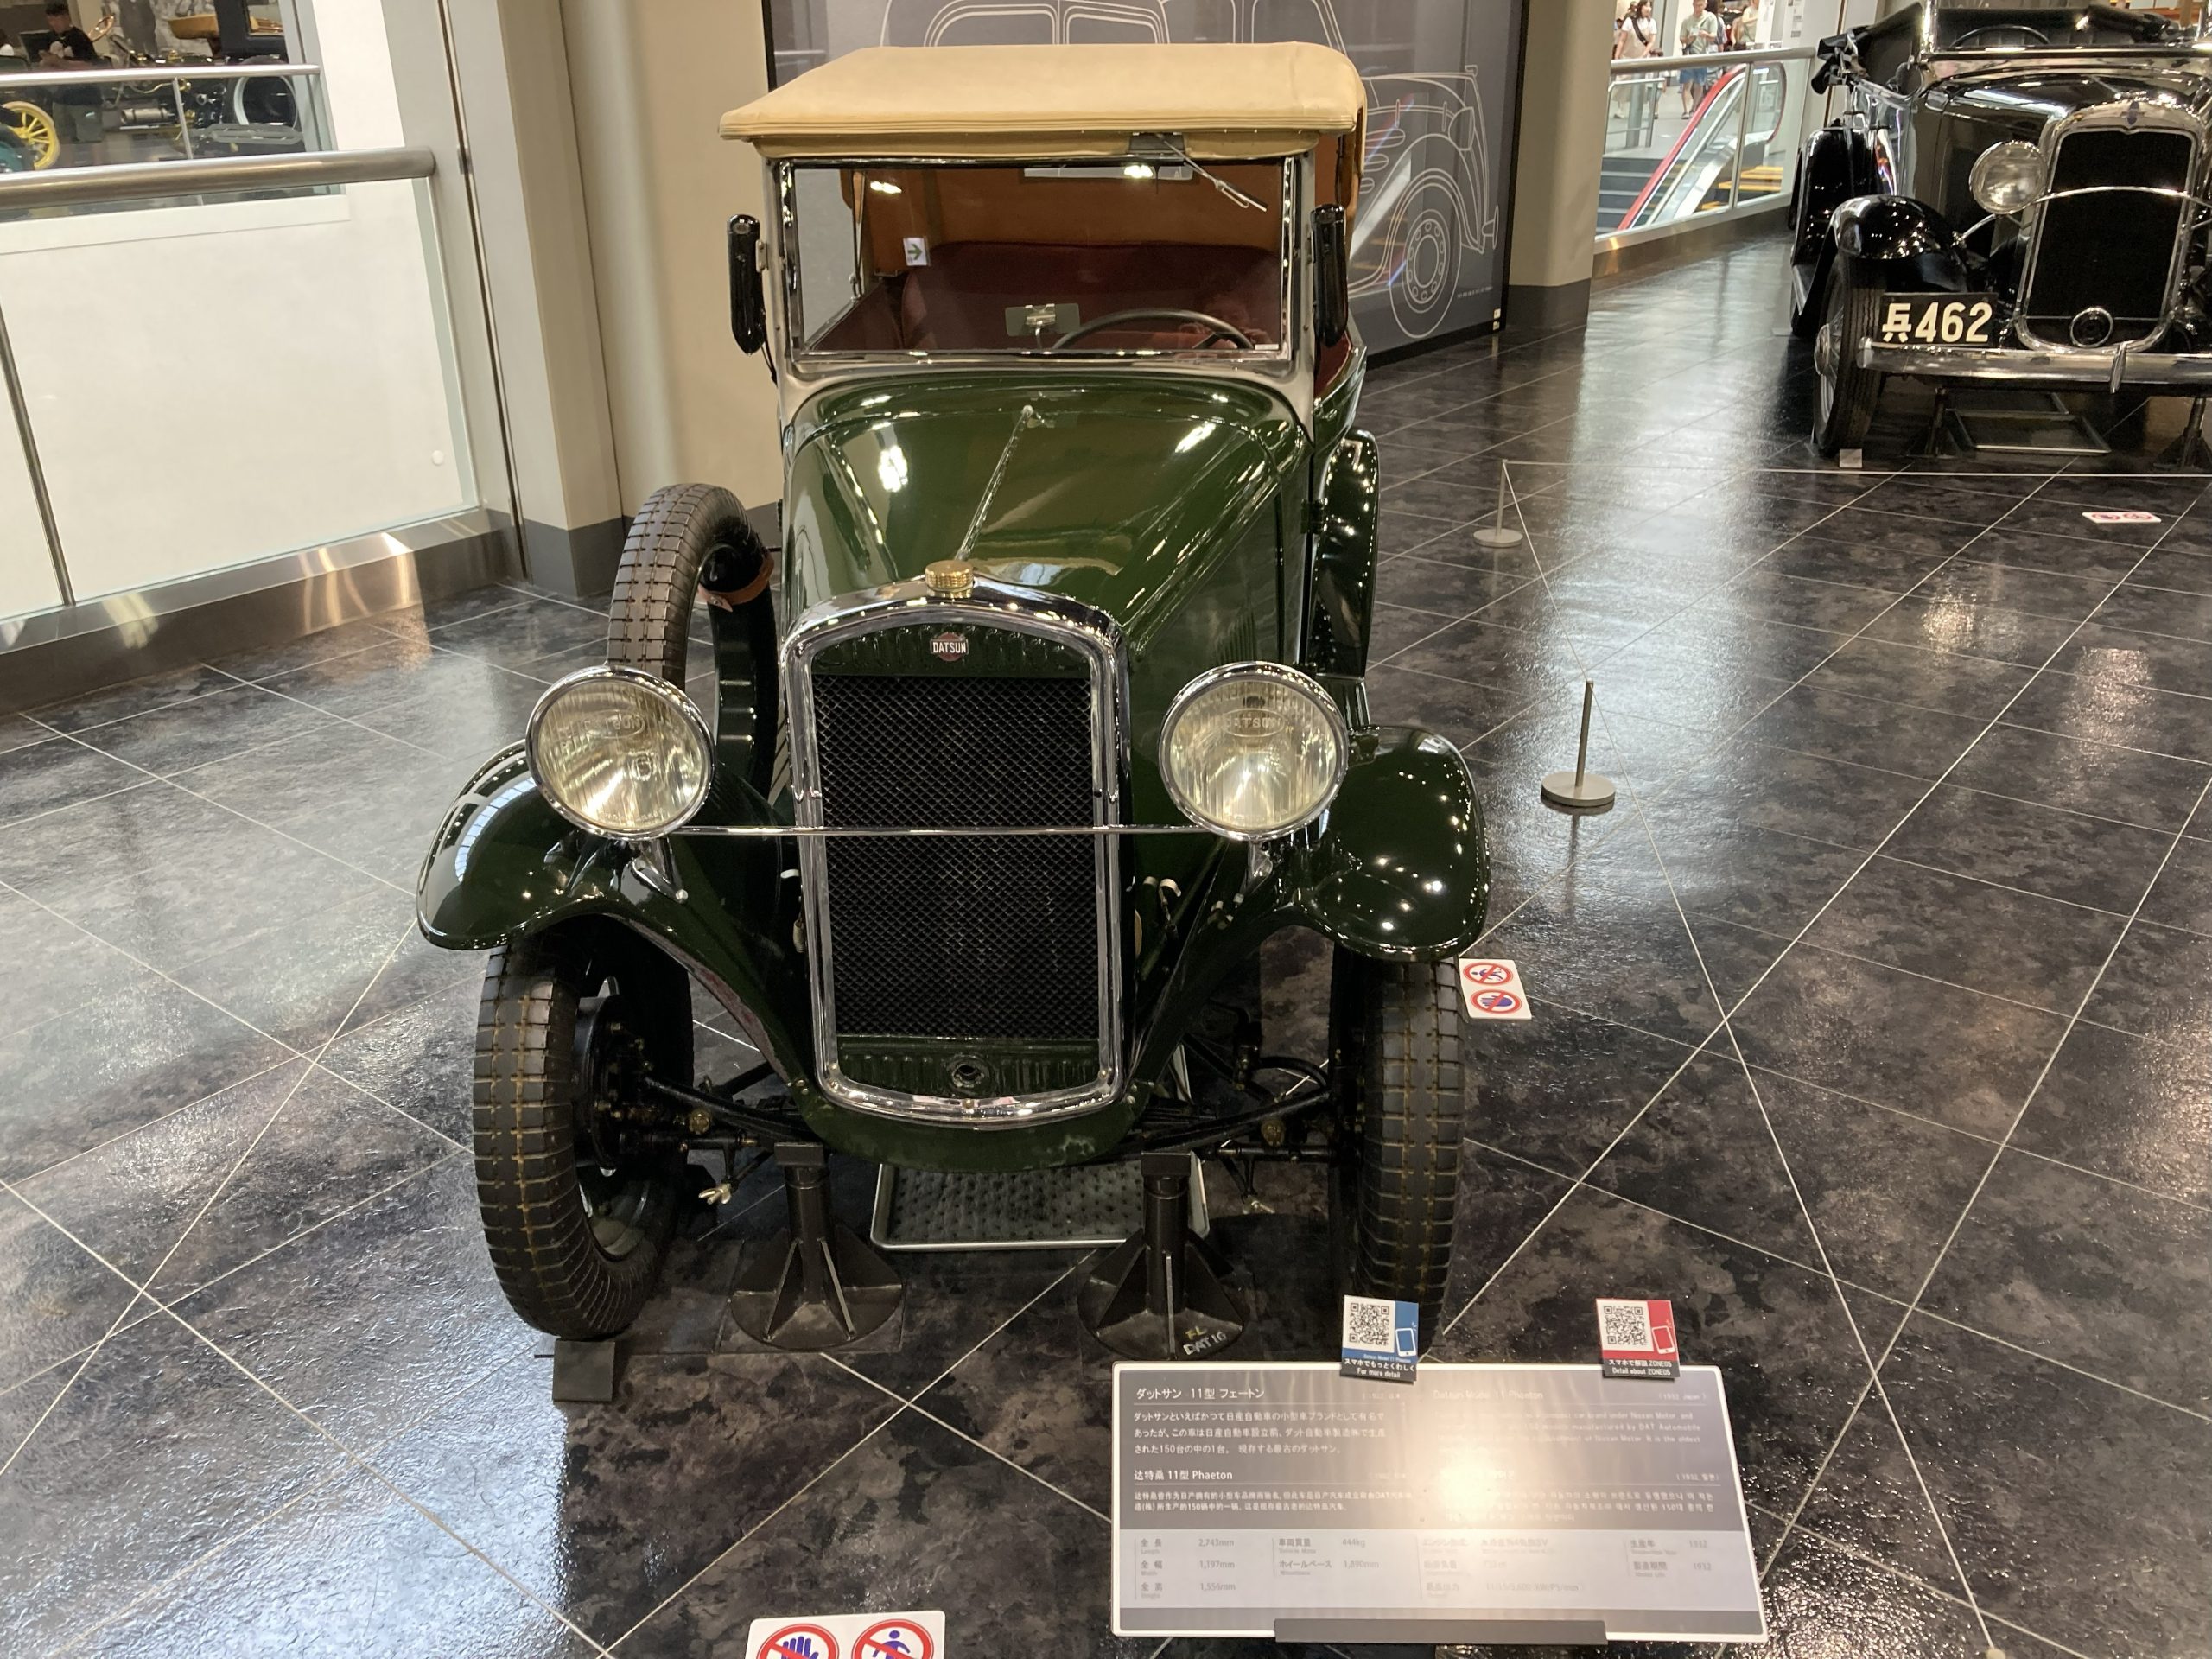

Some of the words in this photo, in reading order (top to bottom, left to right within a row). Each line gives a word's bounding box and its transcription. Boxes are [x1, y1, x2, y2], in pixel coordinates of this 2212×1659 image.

[932, 641, 967, 654] DATSUN
[1344, 1358, 1414, 1372] スマホでもっとくわしく
[1136, 1388, 1182, 1400] ダットサン
[1191, 1388, 1216, 1400] 11型
[1219, 1388, 1265, 1399] フェートン
[1168, 1470, 1189, 1480] 11型
[1192, 1470, 1233, 1480] Phaeton
[1198, 1538, 1235, 1548] 2,743mm
[1342, 1538, 1365, 1548] 444kg
[1199, 1560, 1236, 1569] 1,197mm
[1279, 1560, 1332, 1568] ホイールベース
[1200, 1582, 1236, 1591] 1,556mm
